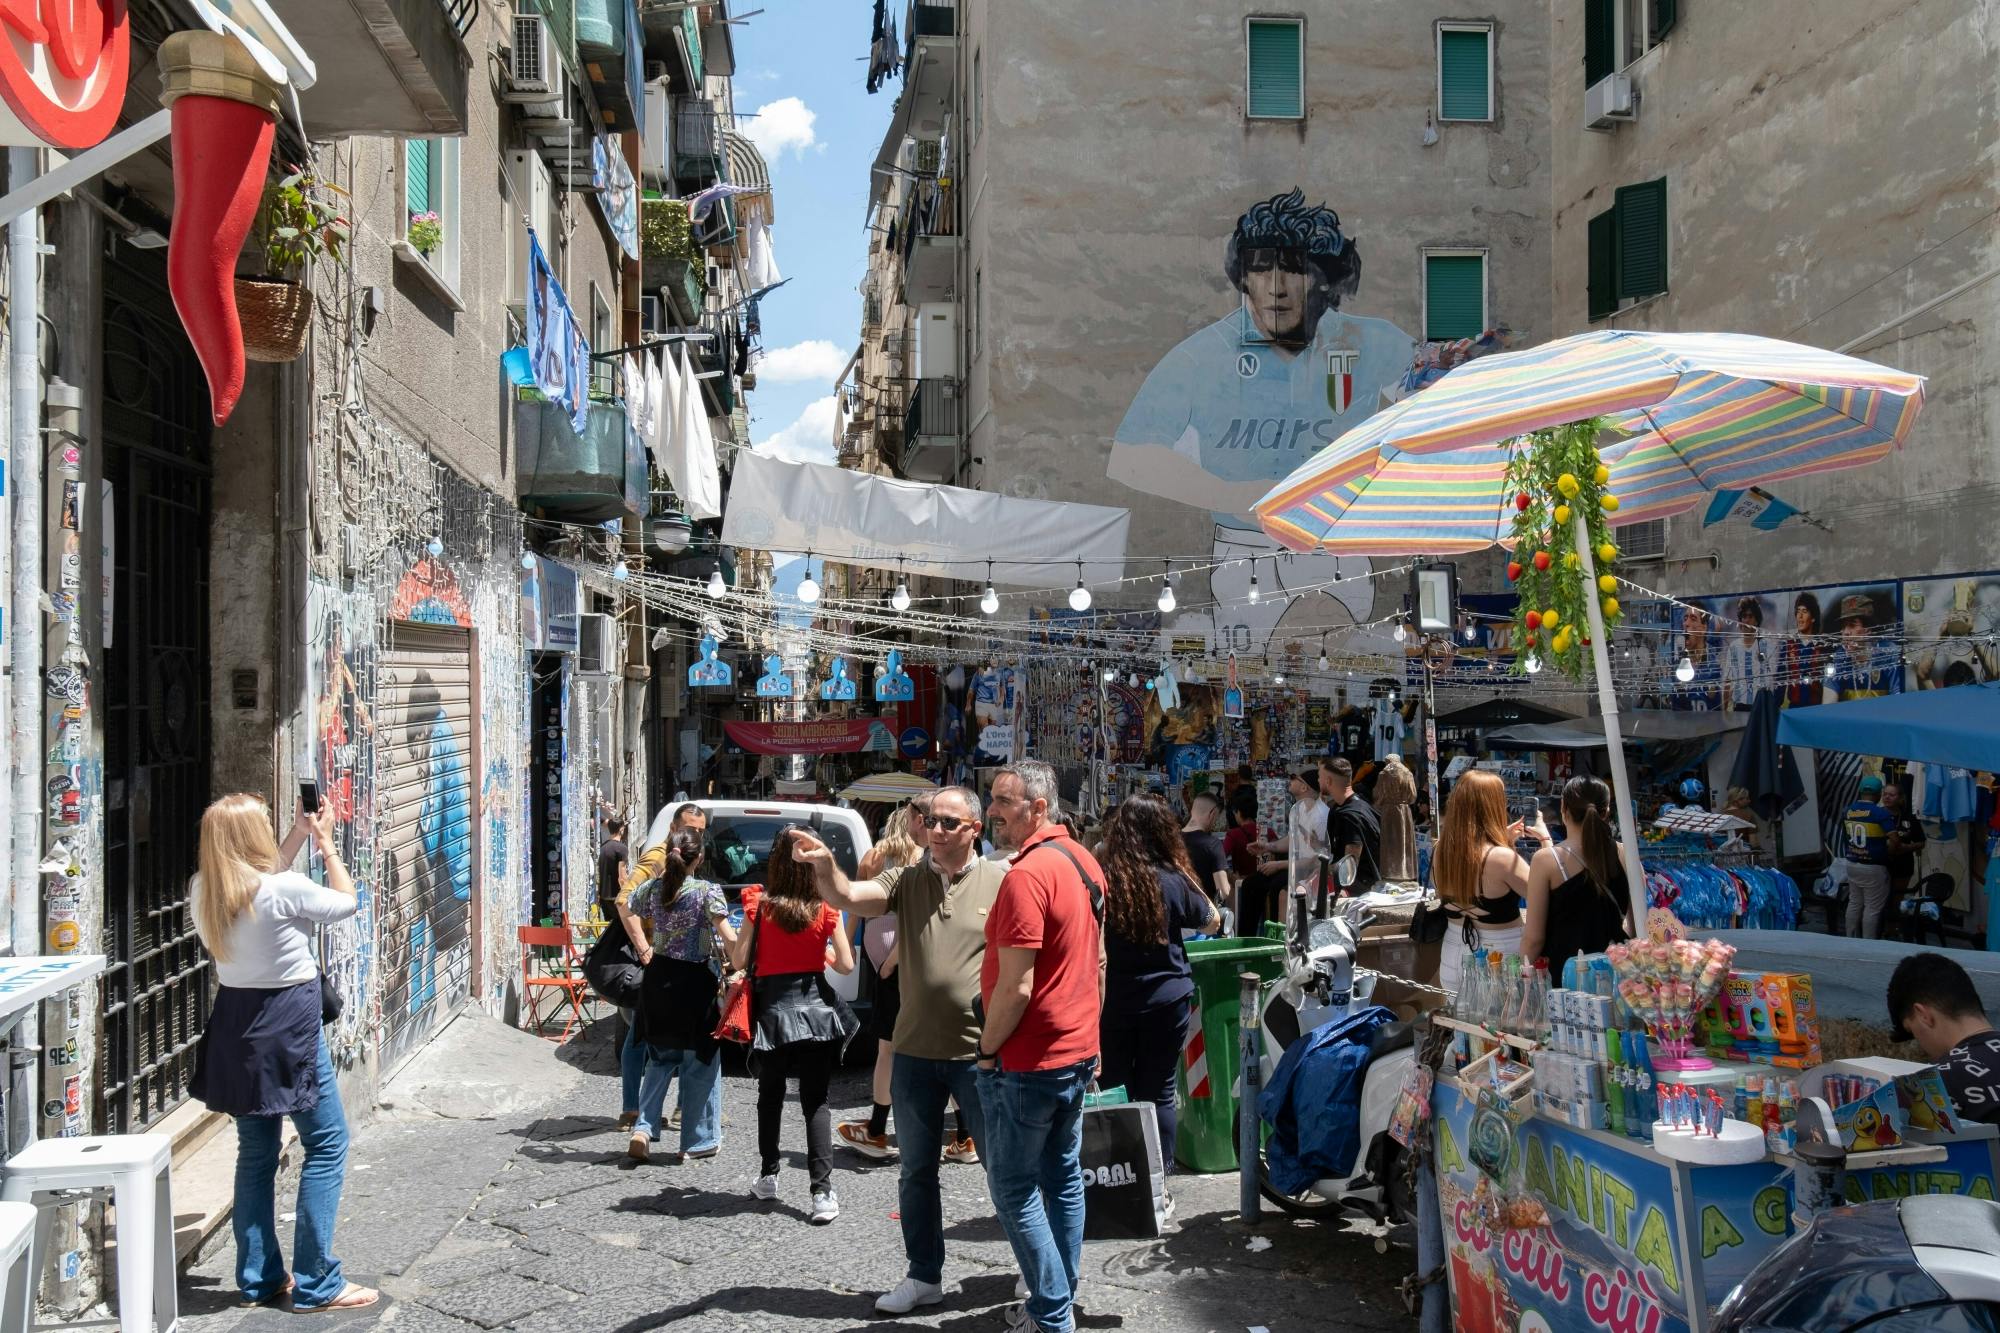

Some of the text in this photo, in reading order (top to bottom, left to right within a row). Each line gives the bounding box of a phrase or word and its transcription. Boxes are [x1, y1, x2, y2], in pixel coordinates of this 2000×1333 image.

[1215, 418, 1334, 450] Mars
[1221, 624, 1251, 652] 10
[772, 737, 806, 745] PIZZERIA
[806, 736, 818, 744] DEI
[819, 735, 860, 744] QUARTIERI
[1380, 725, 1395, 742] 10
[1510, 1134, 1680, 1294] ANITA
